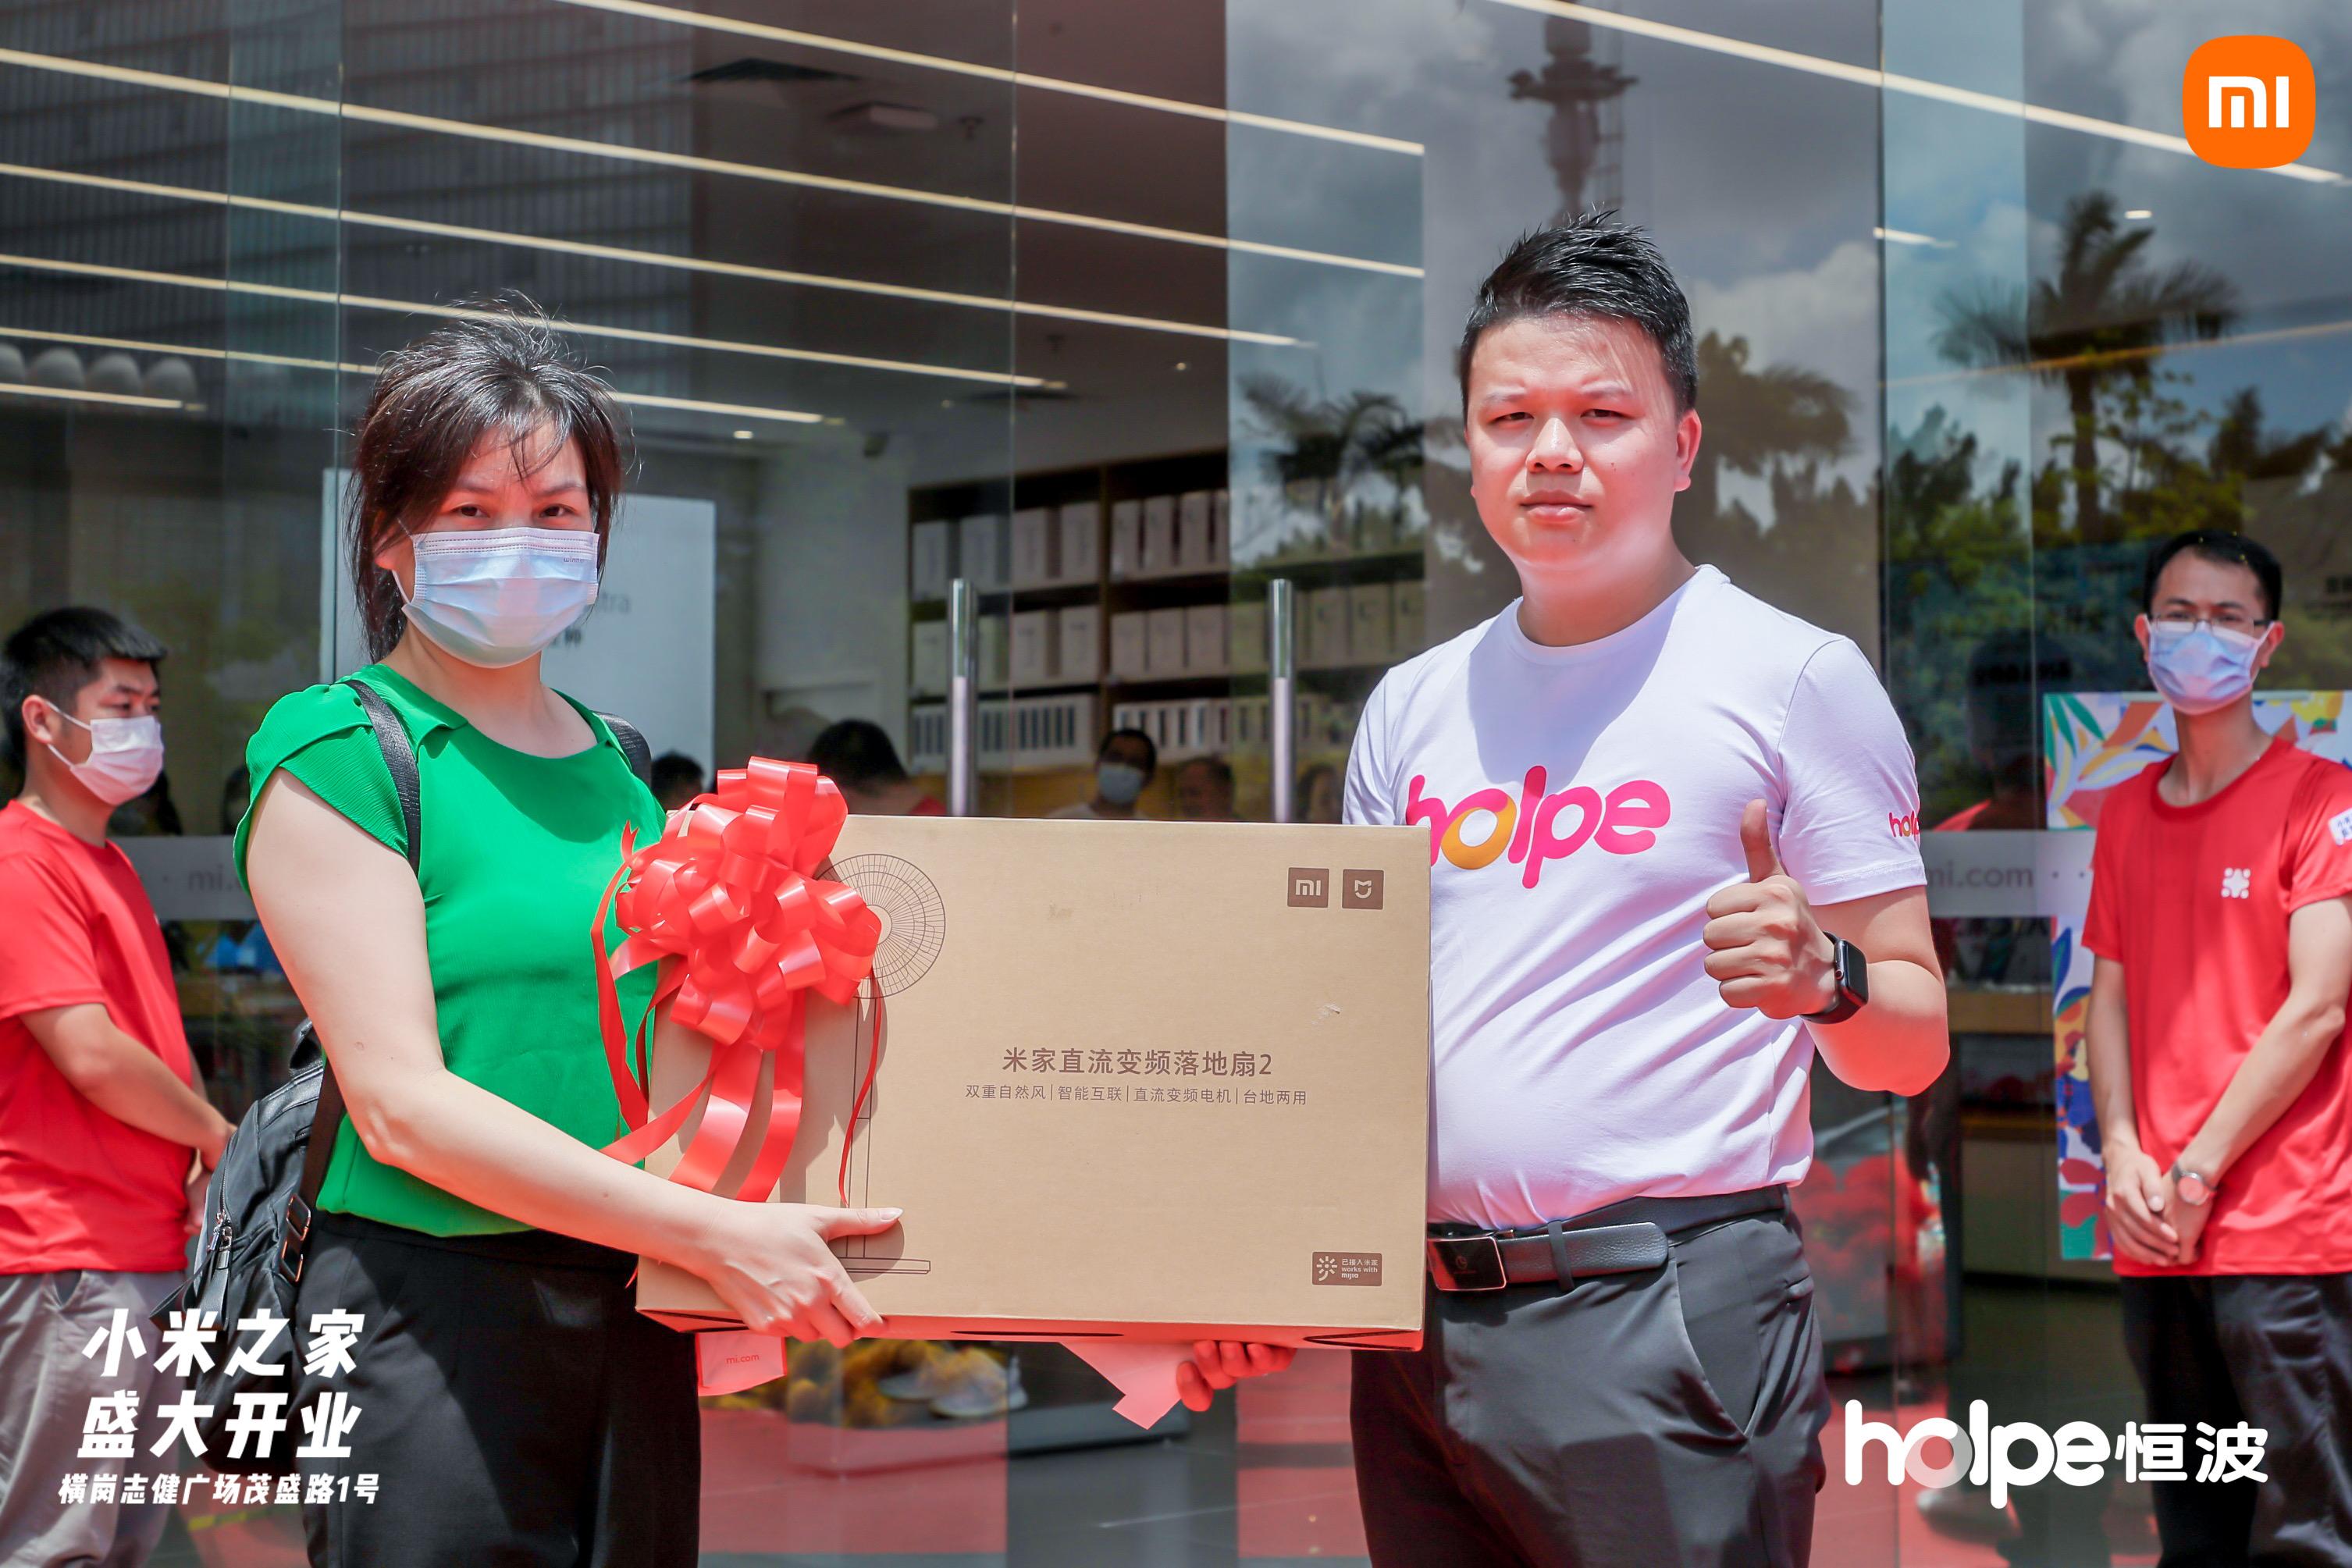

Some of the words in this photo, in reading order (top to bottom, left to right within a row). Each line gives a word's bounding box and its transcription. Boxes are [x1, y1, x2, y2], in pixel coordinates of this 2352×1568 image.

[1406, 765, 1671, 889] holpe
[1002, 1047, 1273, 1077] 米家直流变频落地扇2
[726, 1353, 760, 1364] mi.com
